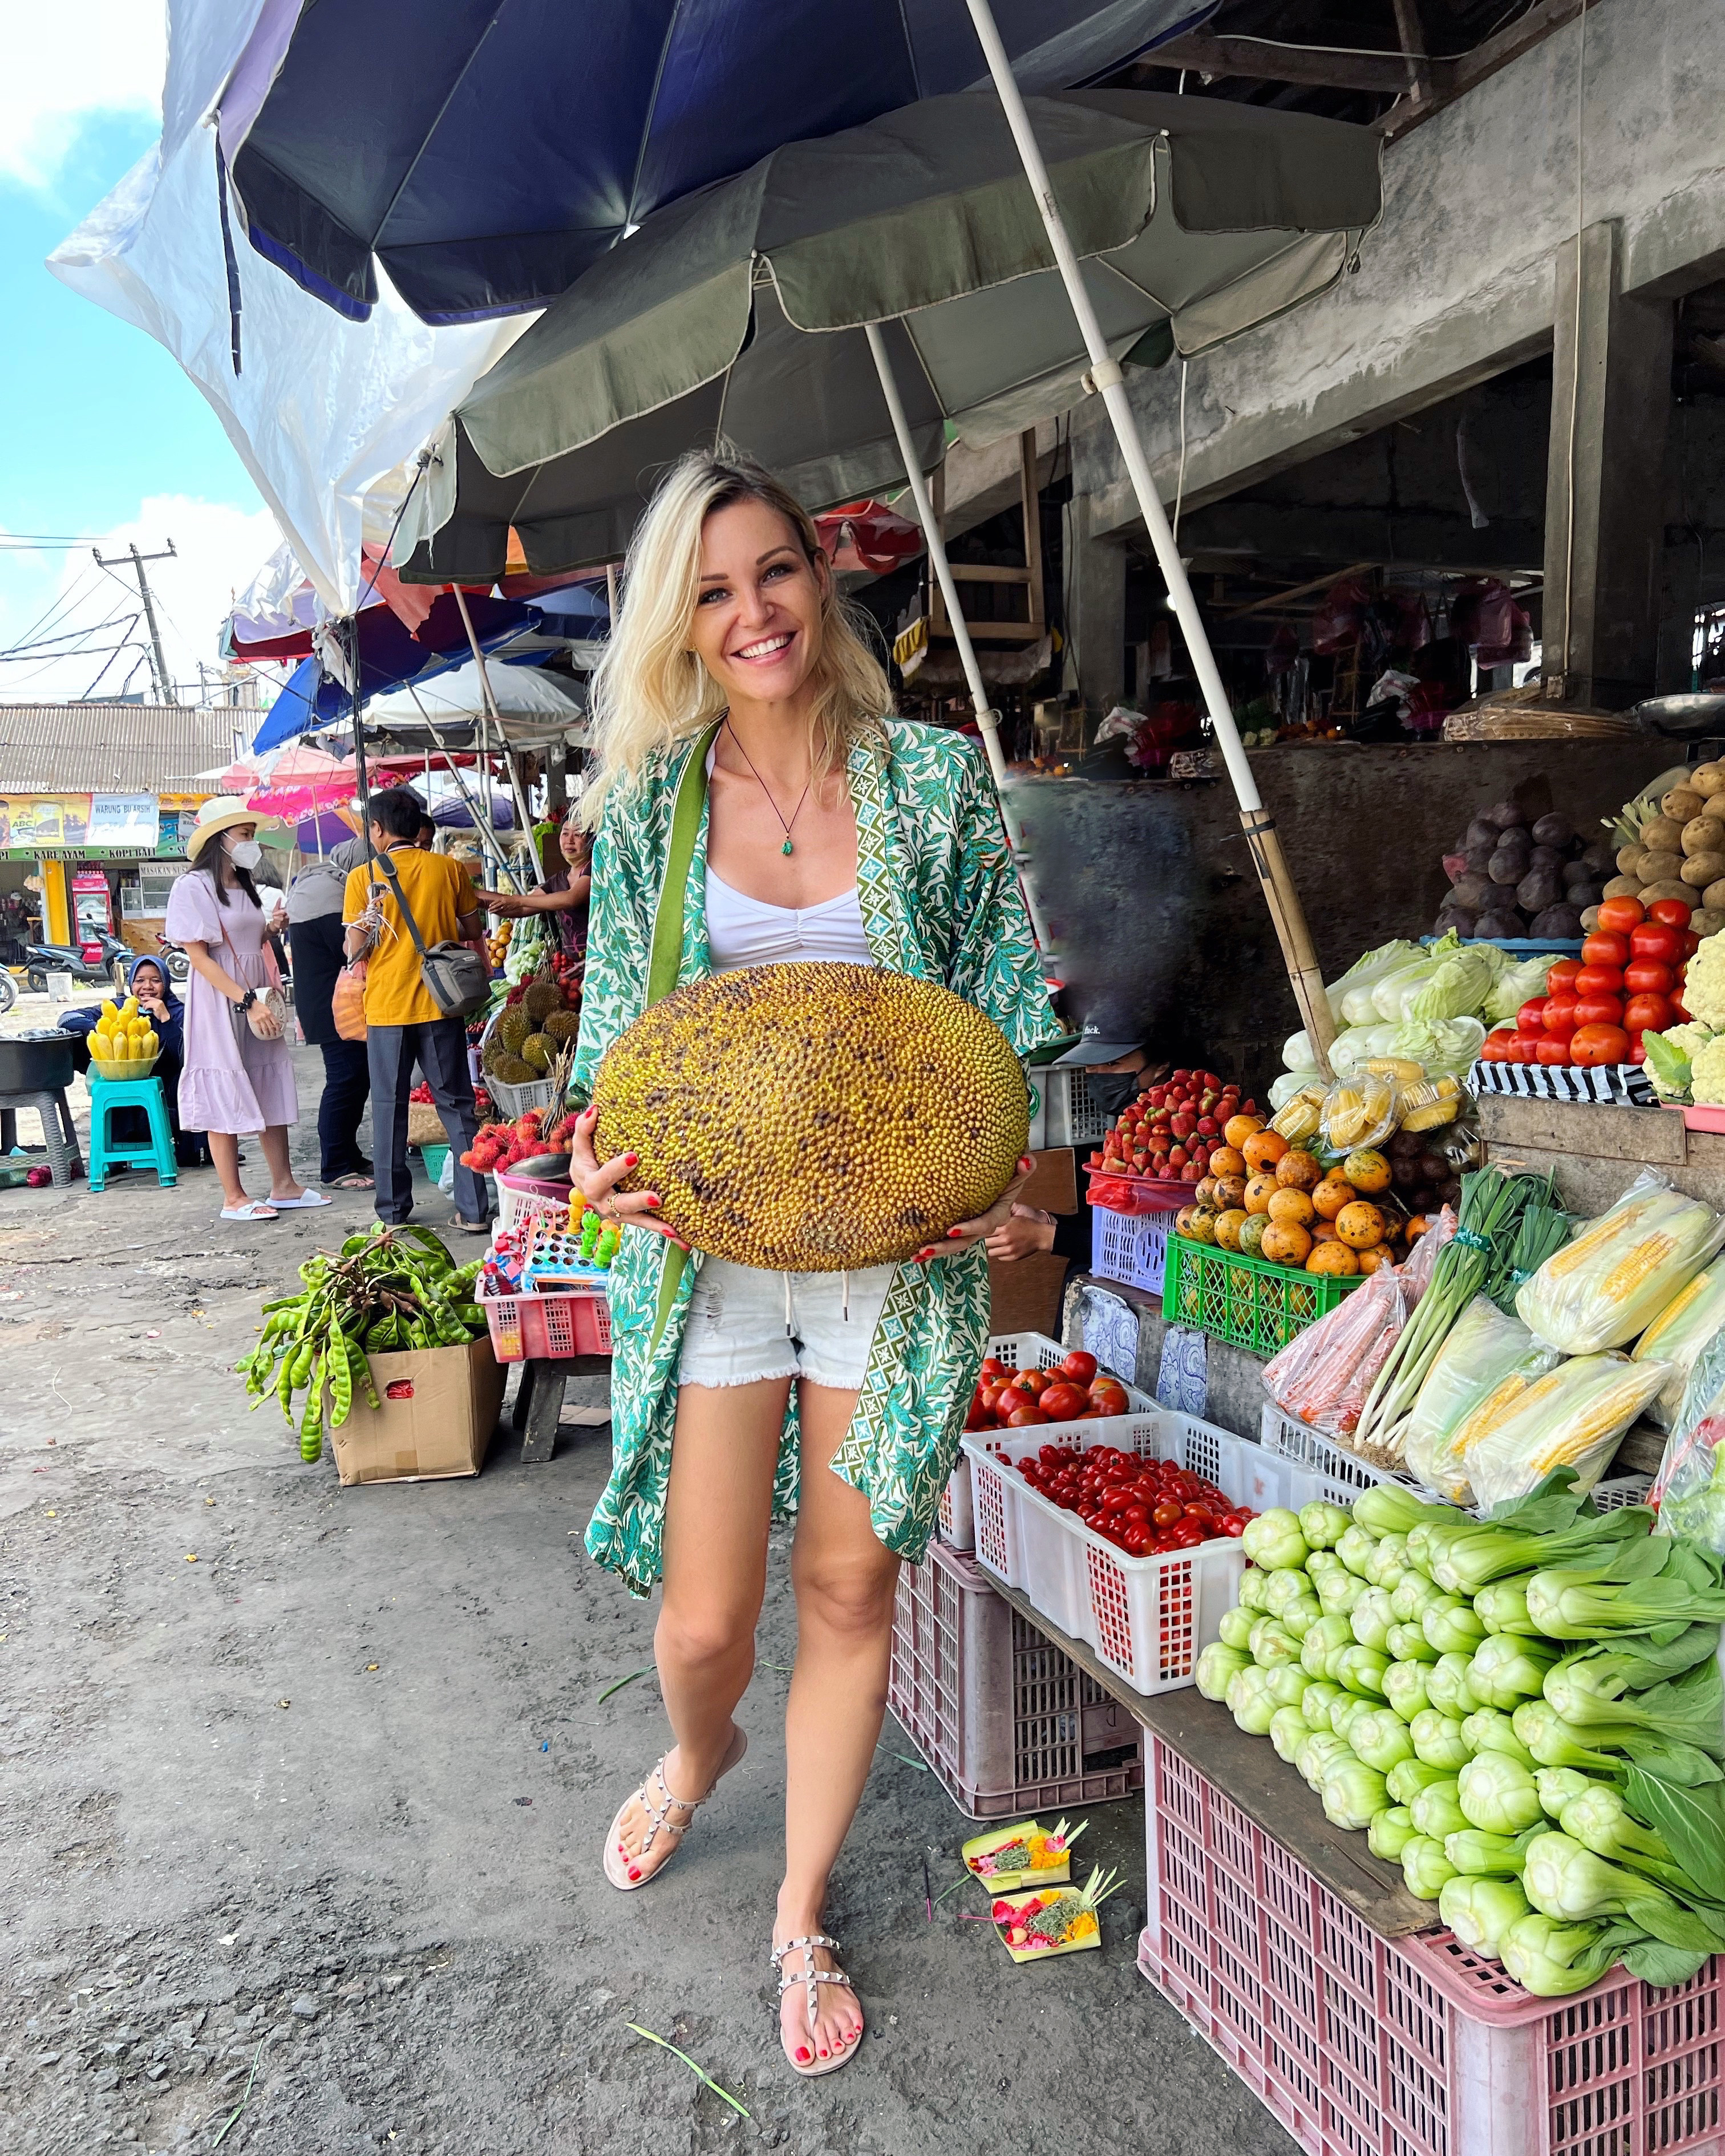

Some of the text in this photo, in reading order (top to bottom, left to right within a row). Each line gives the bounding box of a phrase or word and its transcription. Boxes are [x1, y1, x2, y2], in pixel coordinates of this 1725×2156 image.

[95, 805, 120, 814] WARUNG
[62, 850, 86, 860] AYAM
[109, 847, 156, 858] KOPI BALI
[140, 866, 172, 876] MASAKAN
